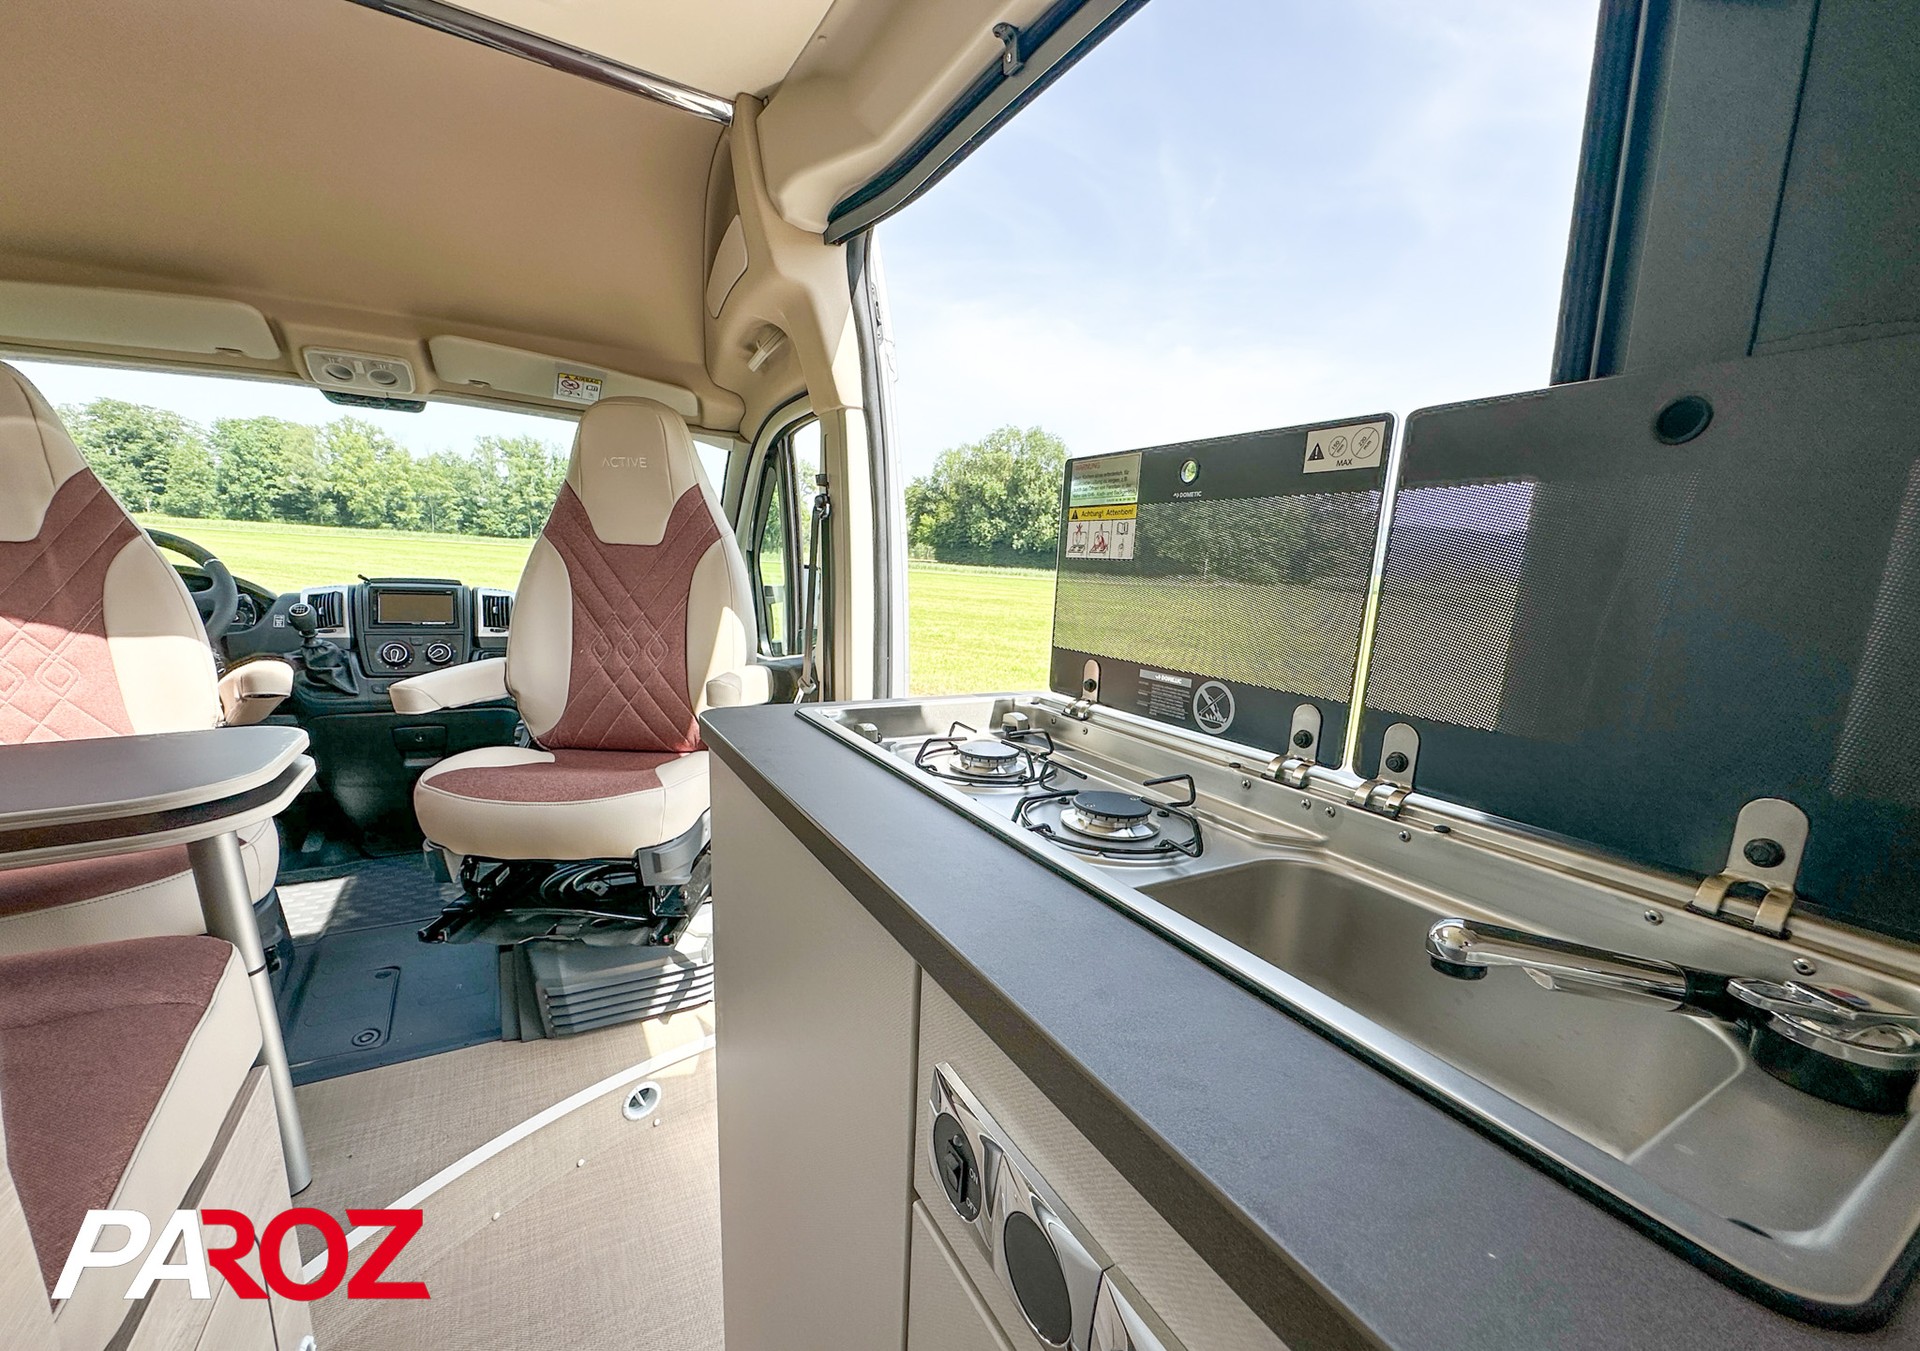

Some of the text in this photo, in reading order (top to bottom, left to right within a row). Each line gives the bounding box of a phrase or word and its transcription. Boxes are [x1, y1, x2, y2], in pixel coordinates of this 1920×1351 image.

[602, 456, 647, 468] ACTIVE
[1336, 458, 1353, 467] MAX
[1179, 490, 1202, 498] DOMETIC
[1081, 507, 1134, 519] Achtung! Attention!
[969, 1167, 978, 1185] ON
[966, 1196, 978, 1215] OFF
